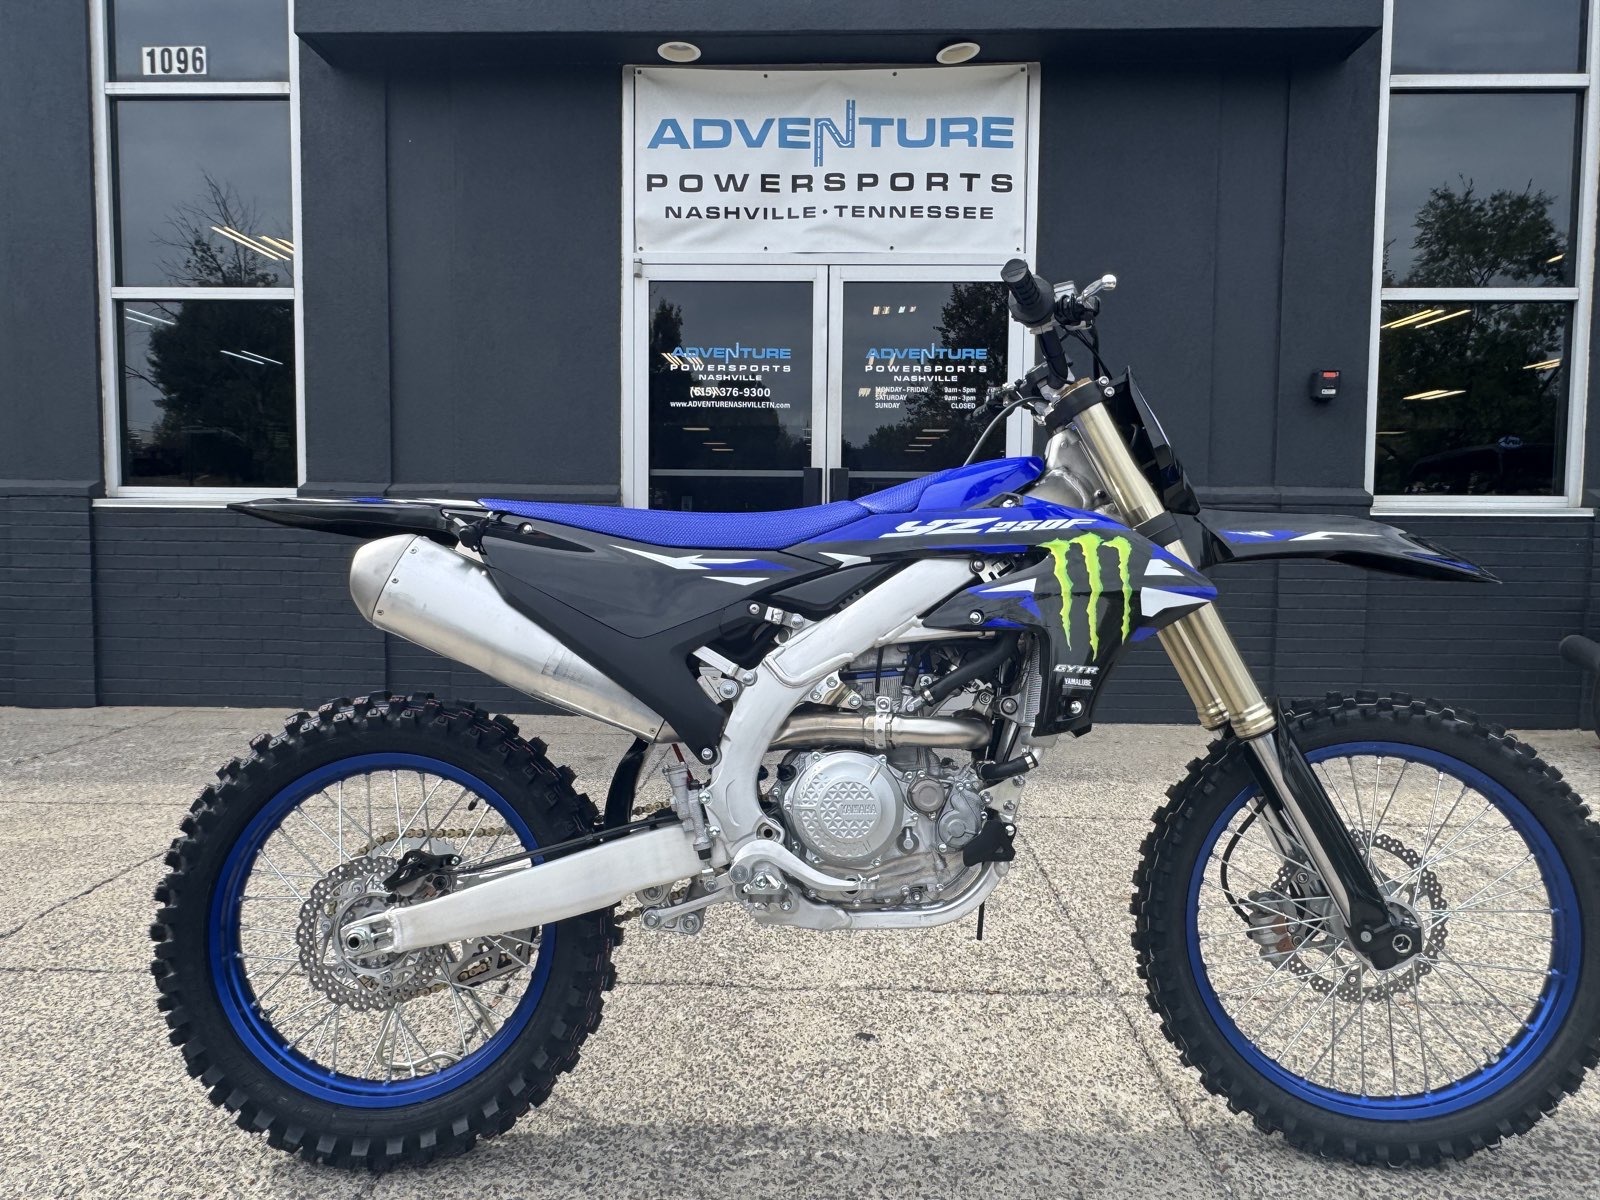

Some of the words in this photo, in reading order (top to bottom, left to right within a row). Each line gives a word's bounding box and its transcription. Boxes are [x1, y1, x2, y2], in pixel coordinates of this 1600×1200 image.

[146, 47, 204, 74] 1096
[647, 99, 1014, 167] ADVENTURE
[646, 173, 1013, 193] POWERSPORTS
[665, 206, 816, 220] NASHVILLE
[834, 205, 994, 219] TENNESSEE
[671, 342, 791, 364] ADVENTURE
[866, 343, 988, 364] ADVENTURE
[670, 364, 791, 372] POWERSPORTS
[865, 365, 987, 373] POWERSPORTS
[720, 387, 771, 397] 376-9300
[1053, 664, 1099, 674] GYTR
